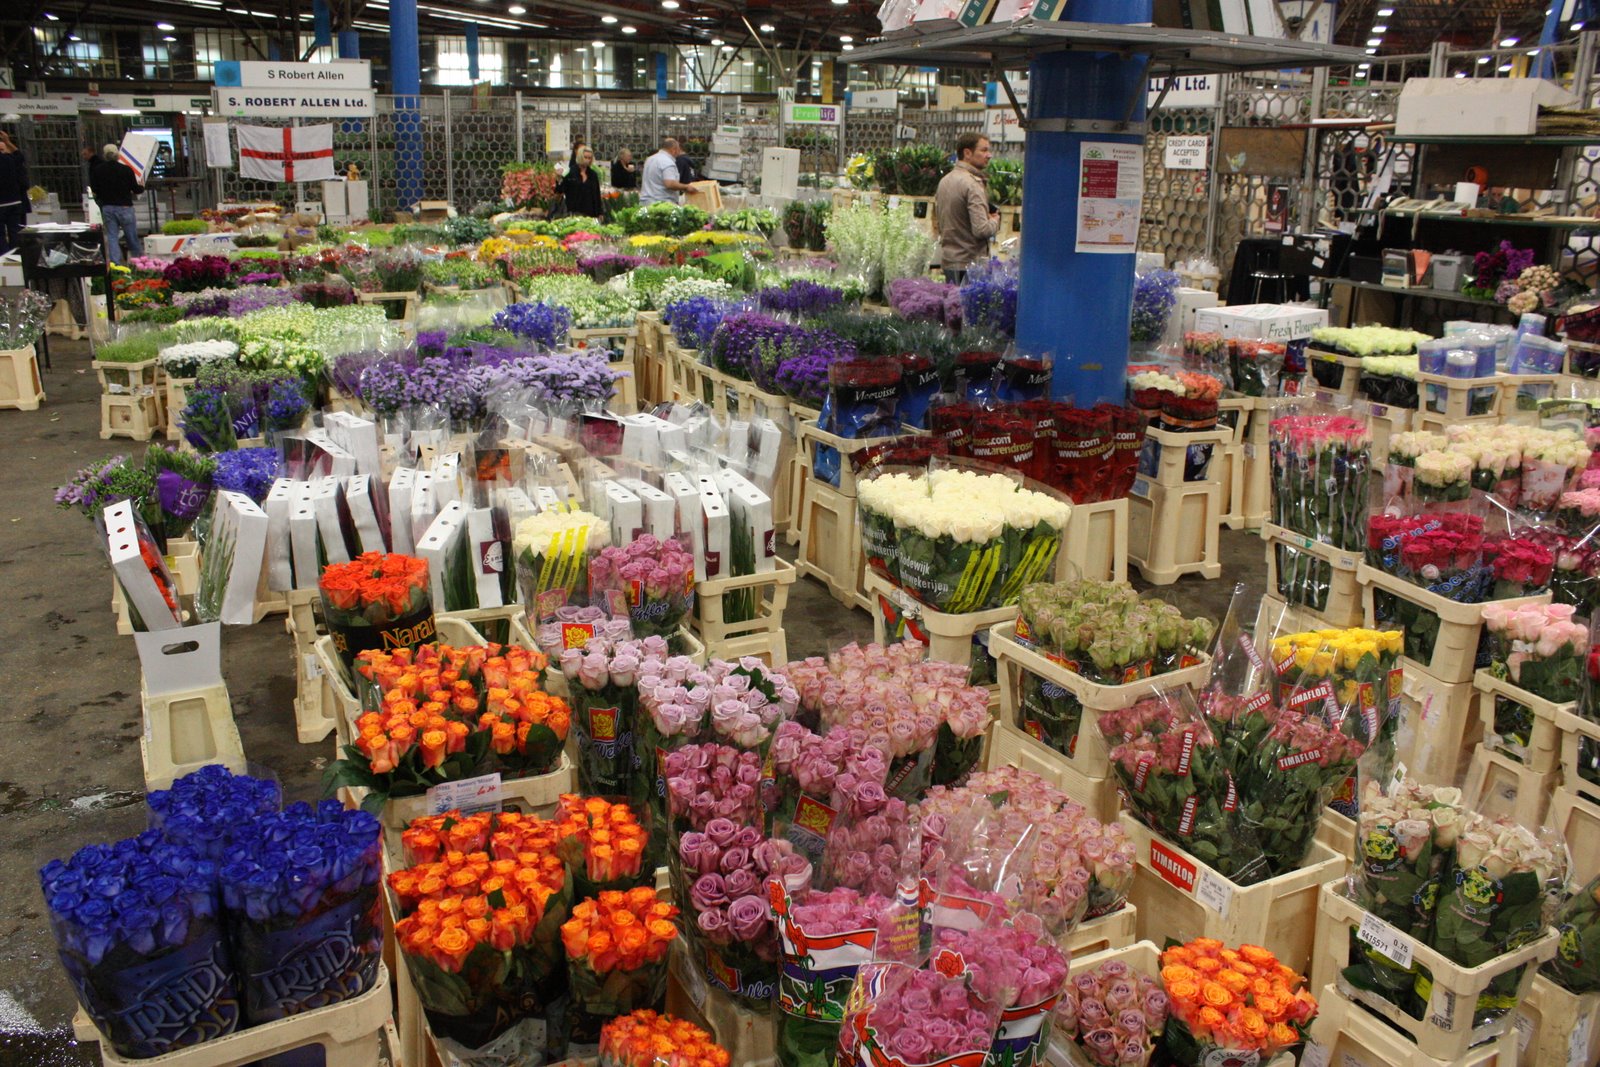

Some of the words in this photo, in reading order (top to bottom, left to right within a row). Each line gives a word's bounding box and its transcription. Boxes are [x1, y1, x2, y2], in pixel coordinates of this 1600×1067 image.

[268, 70, 275, 79] S
[279, 70, 314, 80] Robert
[317, 70, 344, 80] Allen
[1185, 76, 1211, 91] Ltd.
[229, 97, 241, 107] S.
[245, 97, 296, 107] ROBERT
[301, 98, 340, 107] ALLEN
[345, 98, 368, 108] Ltd.
[1173, 149, 1200, 157] ACCEPTED
[1178, 158, 1192, 166] HERE
[1178, 732, 1194, 775] TIMAFLOR
[1279, 749, 1321, 767] TIMAFLOR
[1152, 848, 1194, 886] TIMAFLOR
[1361, 929, 1388, 952] 9415571
[1393, 938, 1409, 953] 0.75
